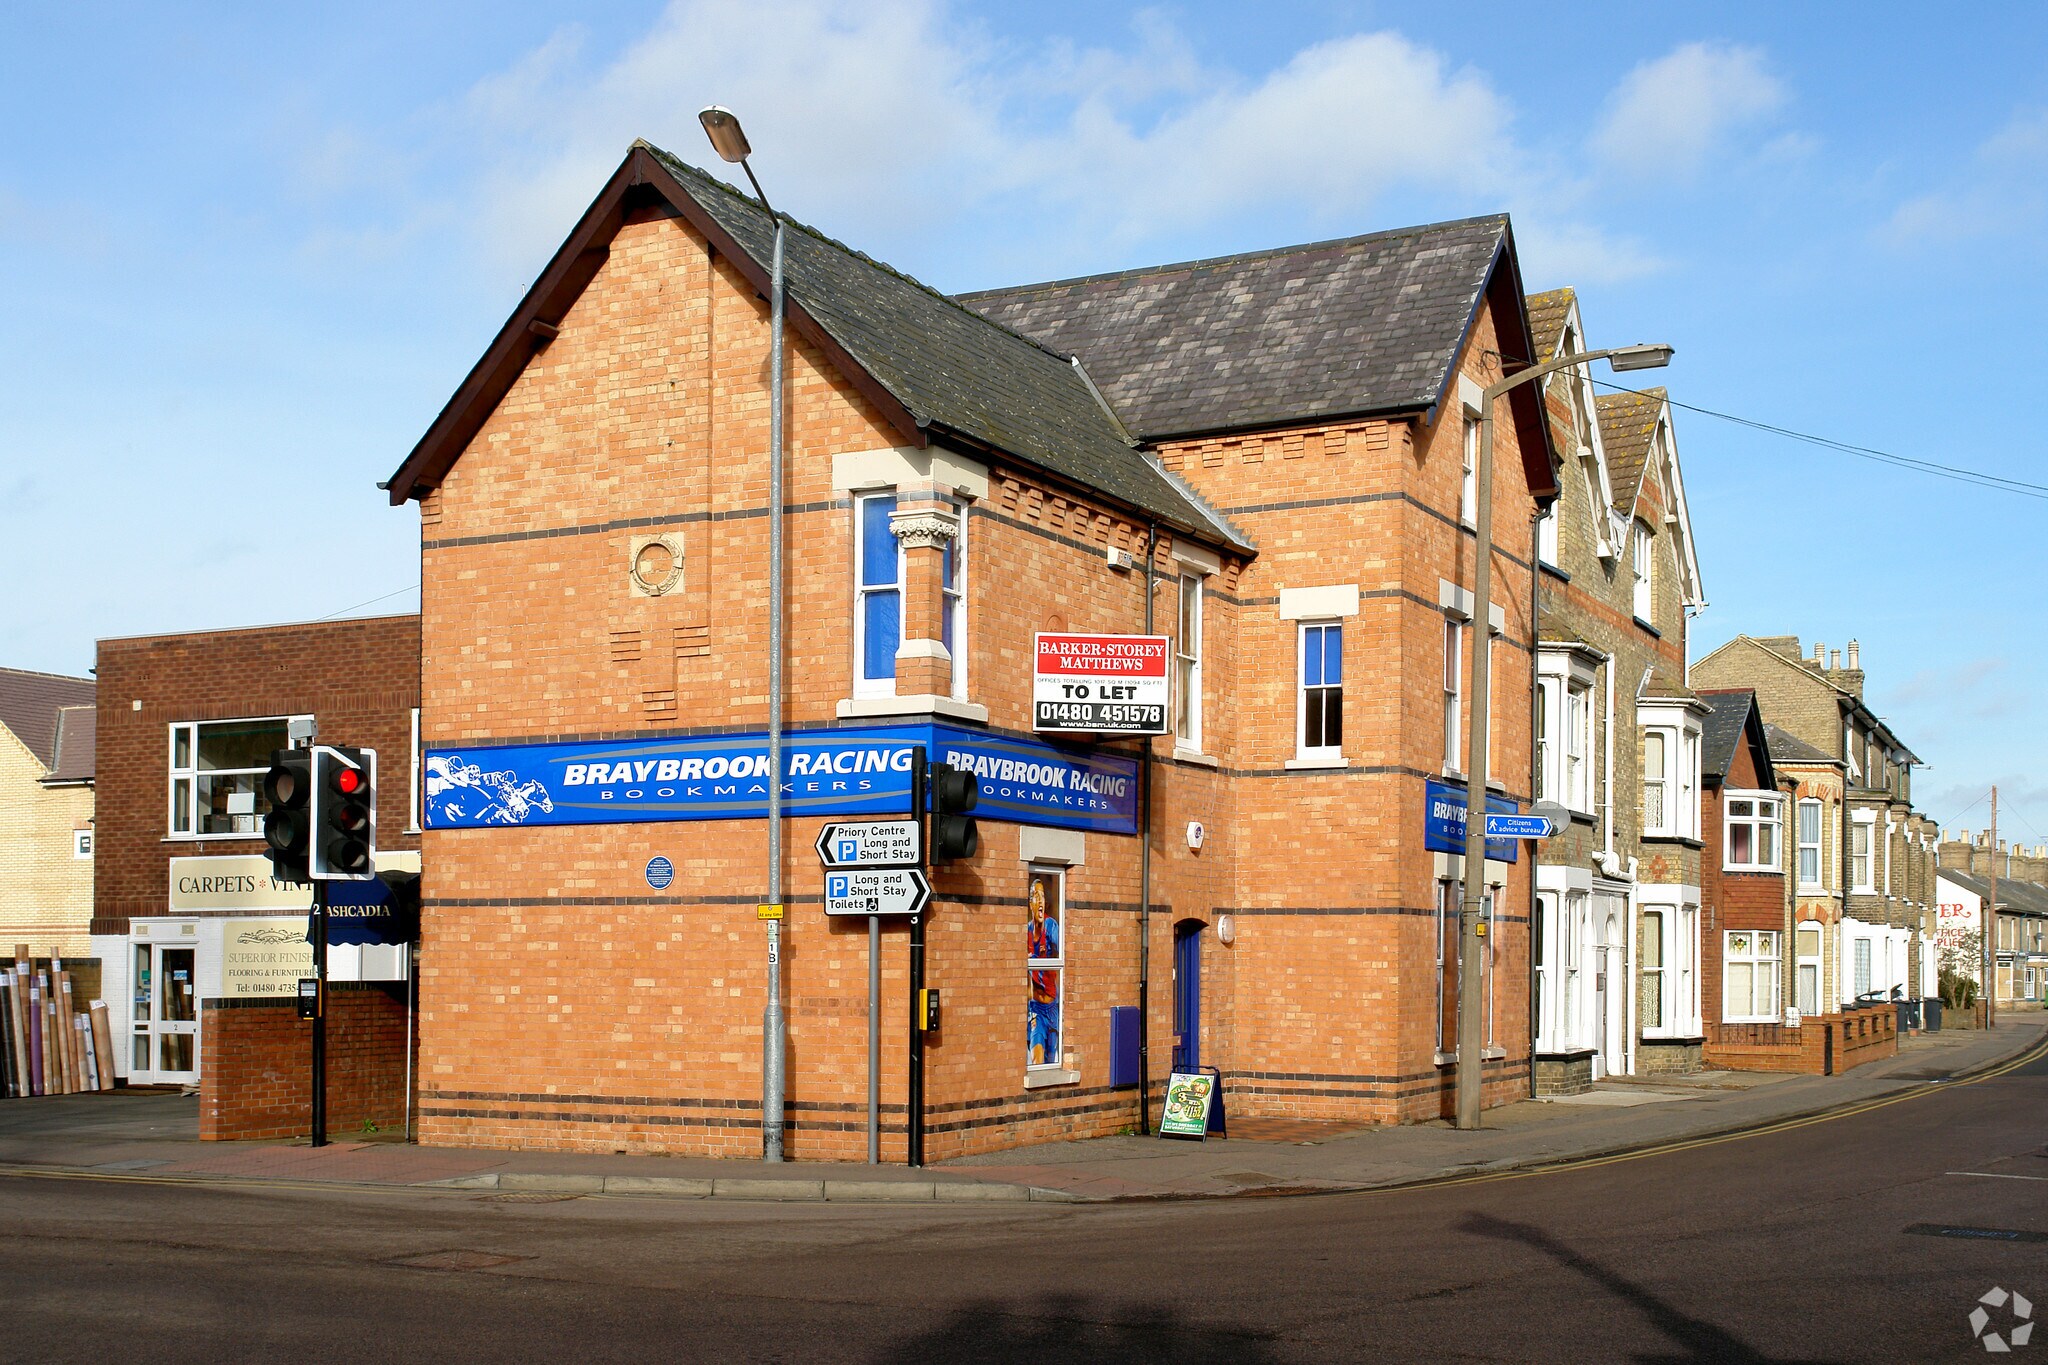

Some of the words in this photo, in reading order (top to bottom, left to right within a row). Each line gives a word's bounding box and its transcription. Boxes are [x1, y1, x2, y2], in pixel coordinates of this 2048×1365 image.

[1060, 656, 1143, 671] MATTHEWS
[1062, 684, 1090, 699] TO
[1099, 685, 1138, 700] LET
[1040, 703, 1093, 720] 01480
[1100, 705, 1160, 722] 451578
[1060, 721, 1141, 729] www.bsm.uk.com
[563, 755, 771, 786] BRAYBROOK
[788, 749, 912, 776] RACING
[601, 779, 872, 800] BOOKMAKERS
[1069, 770, 1127, 798] RACING
[983, 785, 1108, 809] OOKMAKERS
[838, 827, 867, 838] Priory
[871, 826, 906, 836] Centre
[864, 838, 888, 848] Long
[892, 837, 911, 847] and
[842, 842, 854, 859] P
[860, 850, 888, 859] Short
[892, 850, 915, 859] Stay
[179, 876, 255, 893] CARPETS
[855, 875, 879, 885] Long
[883, 874, 902, 883] and
[833, 879, 845, 896] P
[850, 887, 878, 896] Short
[883, 886, 907, 896] Stay
[313, 904, 321, 915] 2
[829, 899, 864, 909] Toilets
[326, 905, 391, 917] ASHCADIA
[1936, 904, 1971, 918] ER
[229, 953, 277, 963] SUPERIOR
[228, 969, 264, 977] FLOORING
[264, 969, 270, 977] &
[236, 983, 250, 993] Tel:
[252, 983, 276, 993] 01480
[278, 983, 299, 993] 4735
[174, 1023, 178, 1031] 2
